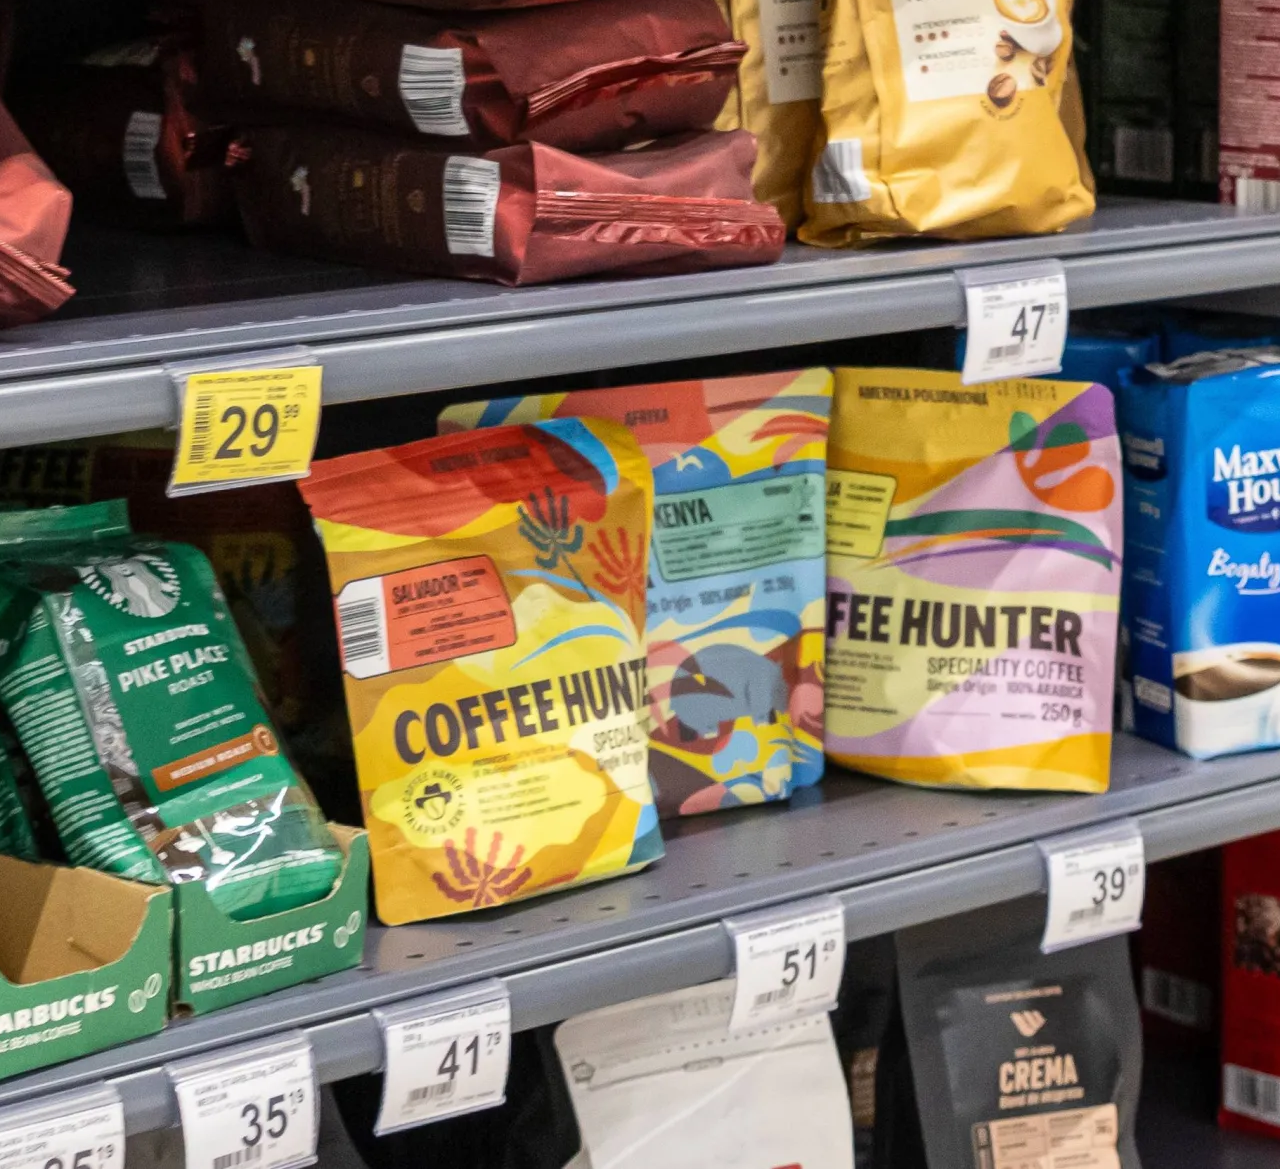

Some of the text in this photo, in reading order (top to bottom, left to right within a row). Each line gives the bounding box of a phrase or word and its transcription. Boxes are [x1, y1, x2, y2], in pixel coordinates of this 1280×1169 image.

[1011, 304, 1047, 342] 47
[214, 403, 279, 460] 29
[654, 498, 714, 529] KENYA
[392, 574, 460, 605] SALVADOR
[123, 623, 210, 656] STARBUCKS
[899, 598, 1083, 658] HUNTER
[117, 644, 229, 693] PIKE PLACE
[167, 670, 214, 696] ROAST
[927, 656, 1084, 683] SPECIALITY COFFEE
[962, 680, 997, 696] Origin
[1035, 683, 1083, 699] ARABICA
[393, 678, 561, 765] COFFEE
[1093, 866, 1125, 906] 39
[187, 922, 329, 979] STARBUCKS
[781, 942, 818, 987] 51
[436, 1034, 480, 1081] 41
[998, 1053, 1080, 1094] CREMA
[240, 1094, 287, 1147] 35
